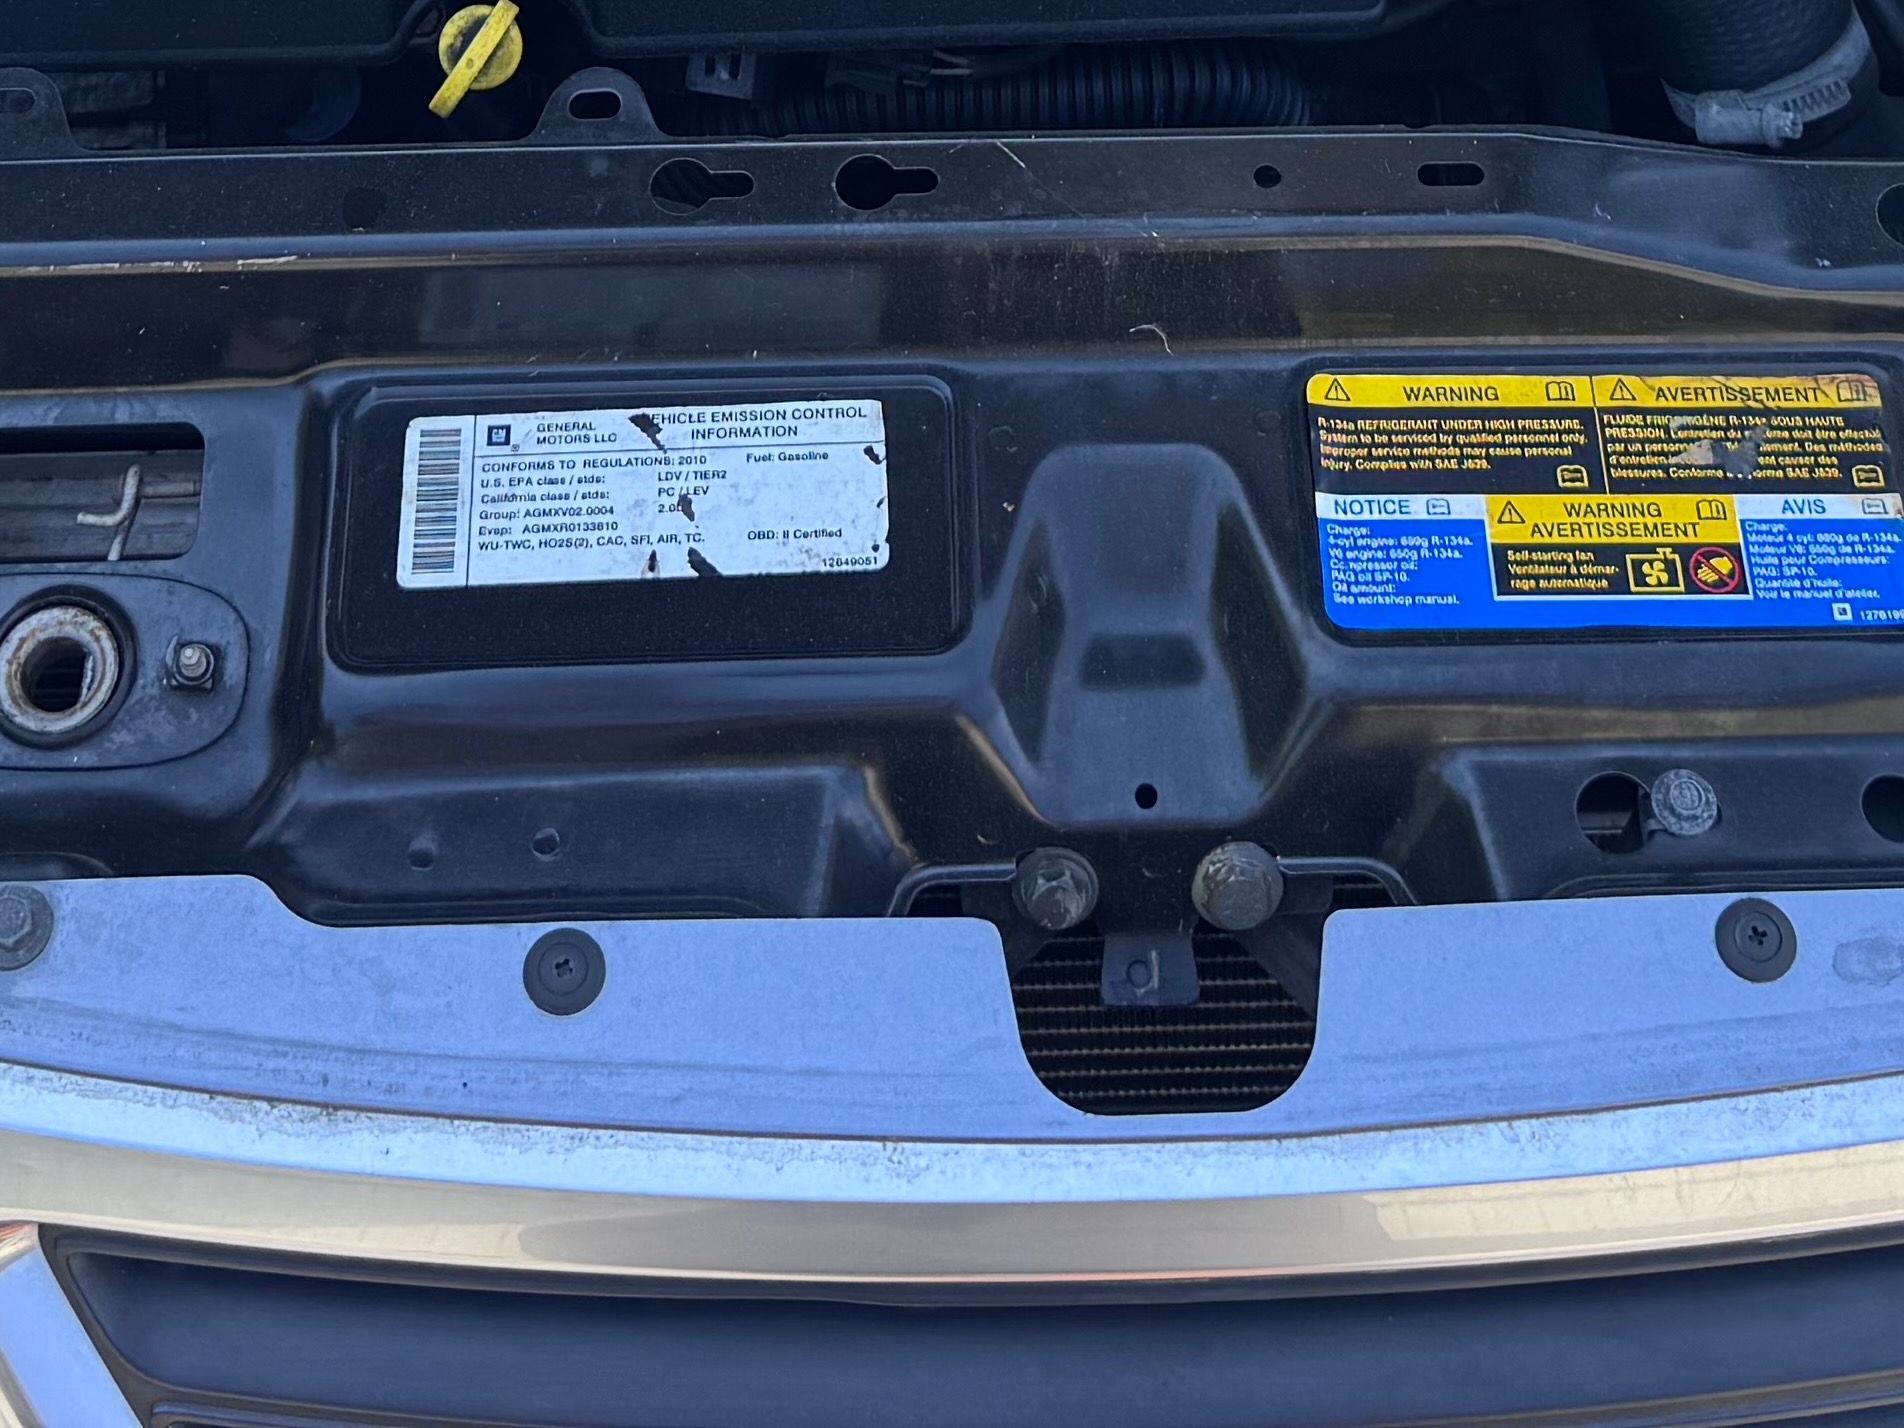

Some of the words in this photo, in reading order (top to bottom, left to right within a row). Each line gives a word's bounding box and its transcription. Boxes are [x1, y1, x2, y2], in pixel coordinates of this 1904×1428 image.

[1403, 386, 1499, 401] WARNING
[1655, 386, 1820, 402] AVERTISSEMENT
[651, 412, 706, 425] EHICLE
[711, 409, 786, 423] EMISSION
[791, 406, 867, 420] CONTROL
[1603, 414, 1644, 425] FLUIDE
[1770, 416, 1803, 426] SOUS
[1805, 416, 1844, 426] HAUTE
[537, 422, 596, 433] GENERAL
[1357, 419, 1438, 430] REFRIGERANT
[1441, 419, 1482, 430] UNDER
[1485, 419, 1515, 430] HIGH
[1518, 419, 1584, 430] PRESSURE.
[537, 434, 591, 445] MOTORS
[691, 426, 798, 440] INFORMATION
[1320, 430, 1358, 444] System
[1360, 433, 1371, 443] to
[1374, 433, 1388, 443] be
[1391, 433, 1437, 443] serviced
[1439, 433, 1453, 445] by
[1455, 433, 1502, 445] qualified
[1505, 433, 1559, 445] personnel
[1561, 434, 1588, 446] only.
[1605, 427, 1669, 439] PRESSION.
[1727, 428, 1742, 439] du
[1320, 444, 1368, 458] Improper
[1371, 446, 1410, 456] service
[1413, 446, 1461, 456] methods
[1463, 447, 1486, 458] may
[1488, 447, 1521, 456] cause
[1524, 445, 1572, 458] personal
[1607, 443, 1625, 454] par
[1627, 443, 1642, 452] un
[1805, 442, 1827, 452] Des
[746, 452, 774, 463] Fuel:
[778, 450, 829, 461] Gasoline
[482, 460, 555, 473] CONFORMS
[559, 459, 576, 470] TO
[583, 456, 675, 469] REGULATIONS:
[678, 456, 707, 465] 2010
[1355, 459, 1407, 472] Complies
[1409, 459, 1433, 469] with
[1435, 459, 1458, 469] SAE
[658, 471, 682, 481] LDV
[693, 469, 727, 480] TIER2
[1610, 467, 1667, 478] blessures.
[1669, 467, 1725, 479] Conforme
[1786, 467, 1809, 478] SAE
[481, 479, 505, 489] U.S.
[509, 477, 533, 487] EPA
[537, 475, 566, 486] class
[577, 475, 605, 485] stds:
[481, 492, 536, 504] California
[540, 491, 570, 502] class
[581, 490, 610, 500] stds:
[658, 487, 675, 497] PC
[1335, 499, 1411, 514] NOTICE
[1563, 501, 1662, 519] WARNING
[1782, 499, 1826, 514] AVIS
[479, 509, 520, 521] Group:
[479, 526, 512, 537] Evap:
[747, 530, 779, 541] OBD:
[793, 528, 843, 539] Certified
[1326, 523, 1370, 537] Charge:
[1531, 522, 1700, 539] AVERTISSEMENT
[478, 540, 535, 552] WU-TWC,
[597, 535, 627, 547] CAC,
[631, 534, 653, 545] SFI,
[657, 533, 681, 544] AIR,
[685, 533, 705, 543] TC.
[1356, 536, 1398, 548] engine:
[1346, 549, 1387, 561] engine:
[1507, 550, 1573, 563] Self-starting
[1575, 550, 1594, 561] fan
[1400, 559, 1418, 570] oil:
[1508, 563, 1567, 575] Ventilateur
[1580, 564, 1619, 574] démar-
[1331, 571, 1355, 582] PAG
[1332, 582, 1350, 593] Oil
[1350, 582, 1396, 594] amount:
[1510, 579, 1536, 591] rage
[1539, 578, 1609, 591] automatique
[1333, 593, 1355, 604] See
[1357, 594, 1413, 607] workshop
[1415, 594, 1460, 605] manual.
